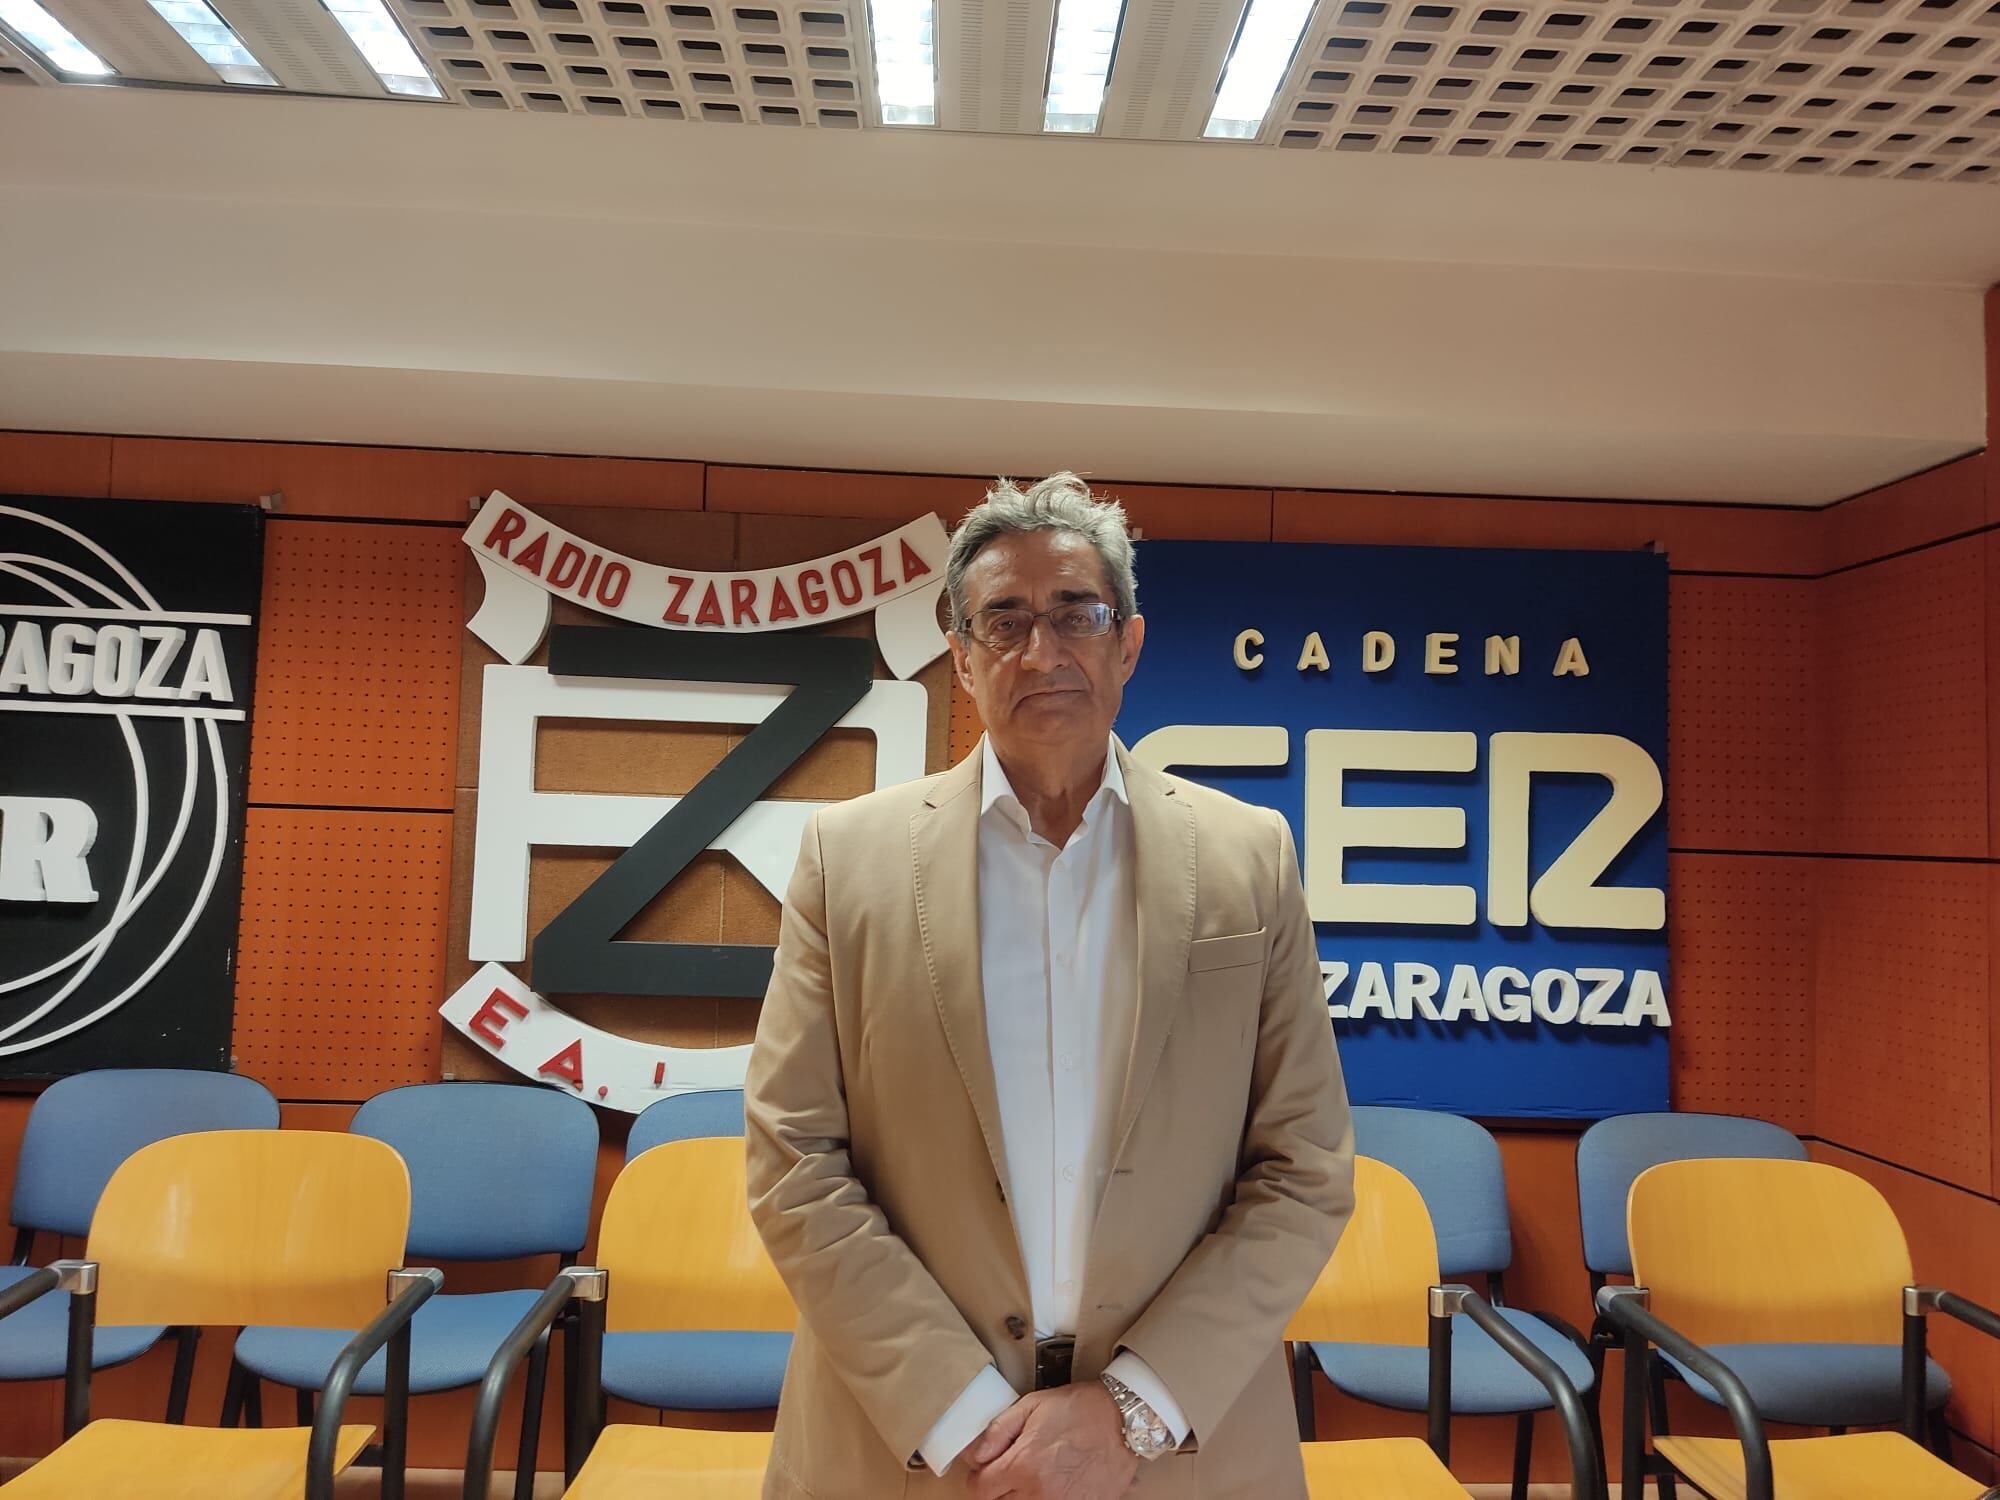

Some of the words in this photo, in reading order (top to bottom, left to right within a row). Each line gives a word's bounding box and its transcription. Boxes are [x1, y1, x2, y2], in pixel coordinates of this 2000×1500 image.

[483, 508, 632, 609] RADIO
[661, 537, 932, 626] ZARAGOZA
[0, 620, 234, 702] AGOZA
[1233, 628, 1590, 677] CADENA
[1318, 960, 1672, 1027] ZARAGOZA
